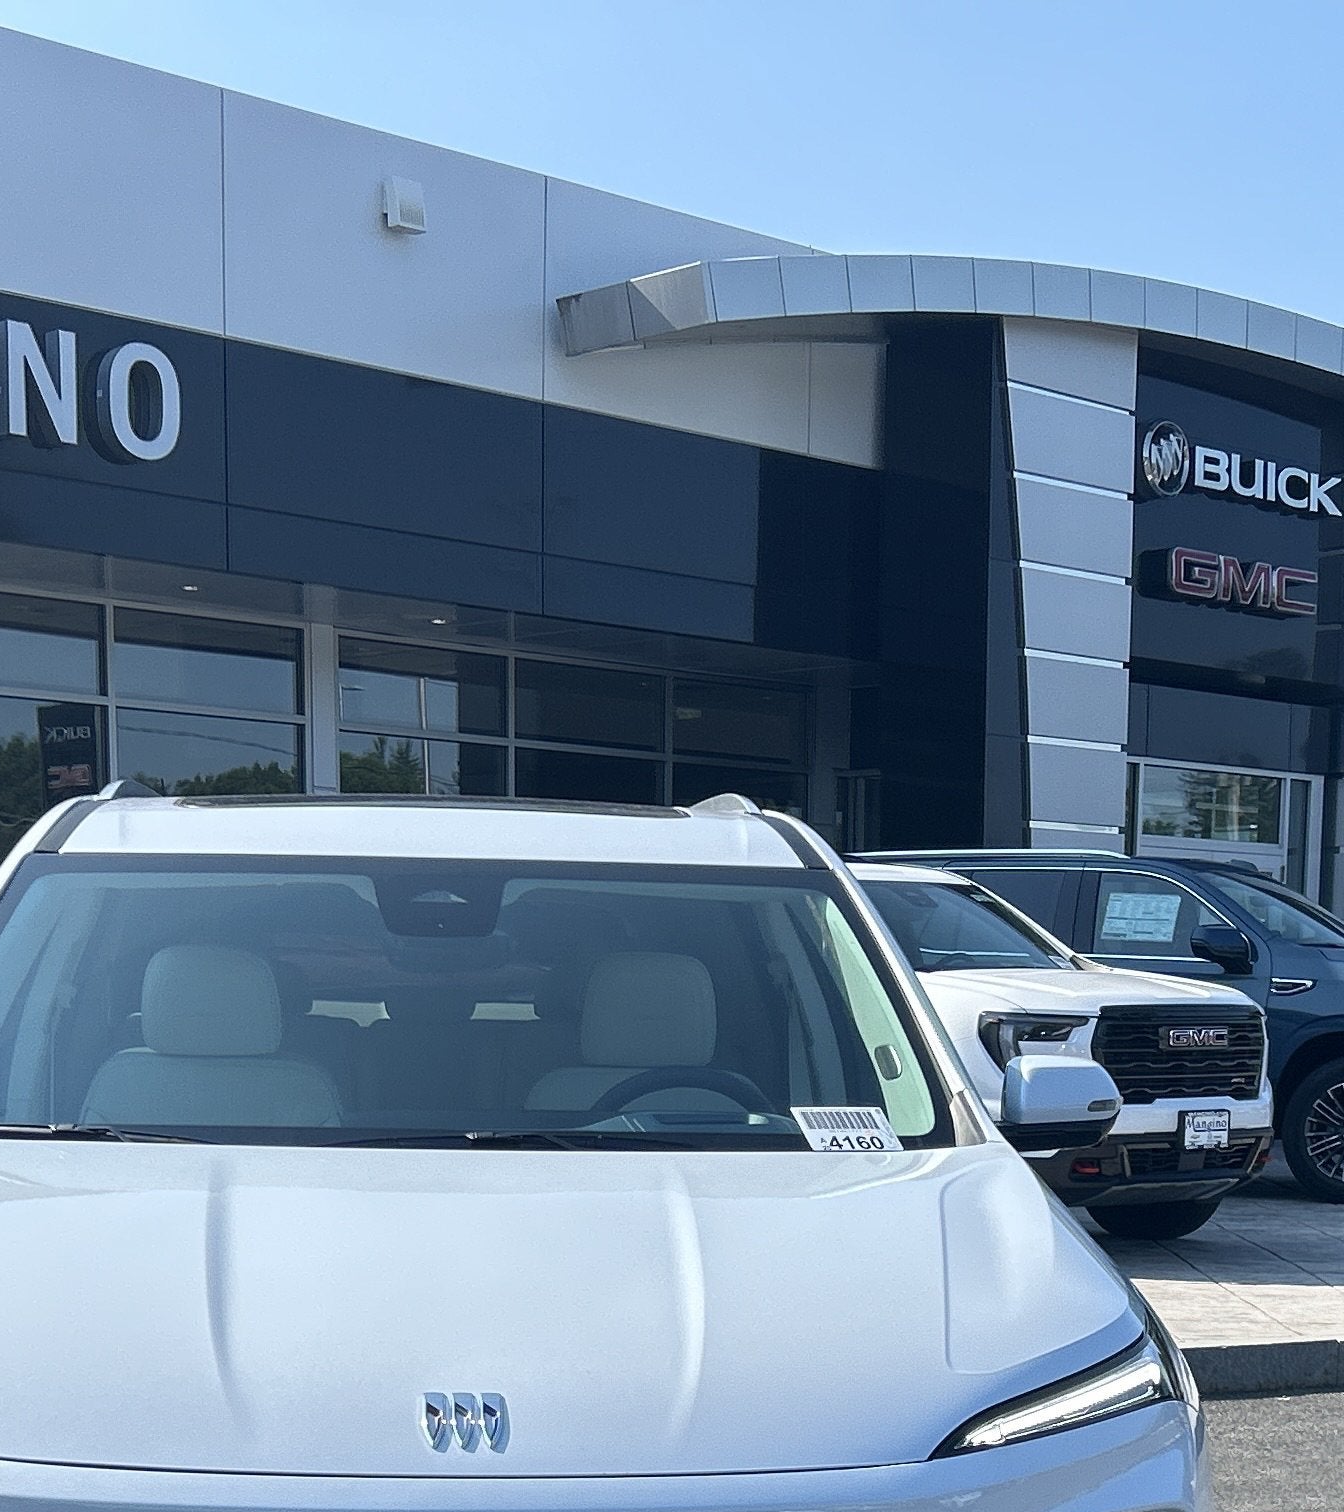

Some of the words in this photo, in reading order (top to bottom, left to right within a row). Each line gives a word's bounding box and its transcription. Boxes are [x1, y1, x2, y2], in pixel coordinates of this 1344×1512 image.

[1194, 445, 1343, 517] BUICK
[1171, 546, 1318, 615] GMC
[1168, 1028, 1229, 1047] GMC
[829, 1135, 885, 1150] 4160
